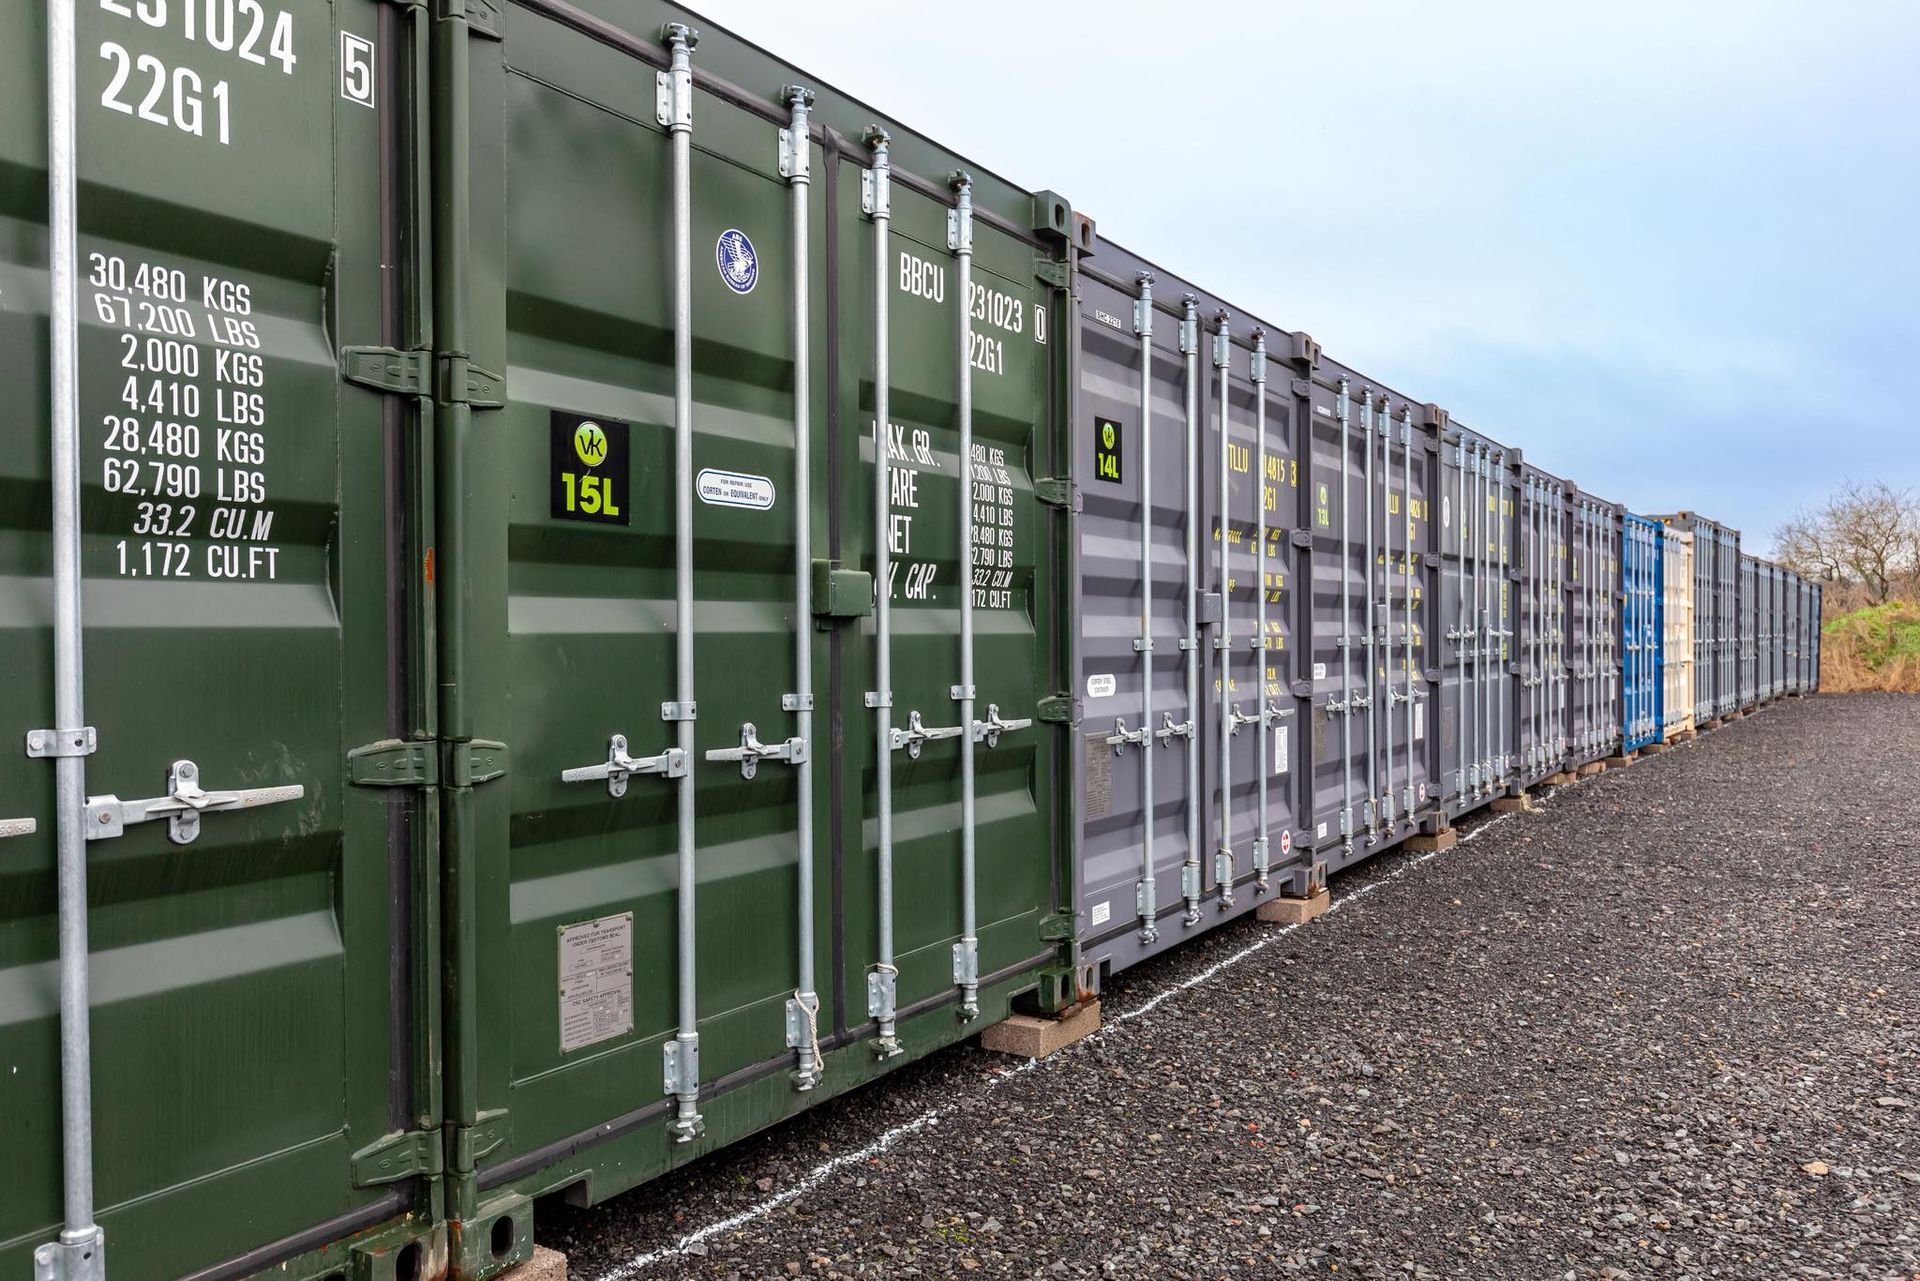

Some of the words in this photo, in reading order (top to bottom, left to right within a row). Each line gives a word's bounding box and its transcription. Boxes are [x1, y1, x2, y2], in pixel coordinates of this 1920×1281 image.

[100, 0, 297, 75] 1024
[345, 37, 370, 101] 5
[100, 41, 230, 145] 22G1
[203, 276, 251, 315] KGS
[900, 252, 944, 303] BBCU
[970, 281, 1023, 333] 231023
[207, 315, 260, 349] LBS
[120, 334, 199, 377] 2,000
[215, 349, 264, 387] KGS
[970, 330, 1003, 375] 22G1
[122, 375, 200, 418] 4,410
[216, 389, 265, 426] LBS
[103, 415, 200, 458] 28,480
[216, 428, 265, 464] KGS
[873, 420, 914, 462] AX.
[913, 429, 941, 467] GR.
[989, 447, 1004, 467] KGS
[1228, 443, 1248, 473] TLLU
[103, 458, 200, 498] 62,790
[217, 468, 265, 504] LBS
[992, 467, 1011, 485] LBS
[1098, 452, 1119, 478] 14L
[562, 472, 619, 516] 15L
[703, 486, 722, 496] CORTEN
[731, 489, 758, 500] EQUIVALENT
[888, 466, 918, 508] ARE
[998, 486, 1013, 506] KGS
[133, 502, 196, 537] 33.2
[209, 508, 274, 541] CU.M
[970, 525, 995, 545] 8,480
[998, 528, 1013, 547] KGS
[998, 507, 1013, 527] LBS
[116, 540, 191, 576] 1,172
[207, 545, 279, 579] CU.FT
[970, 547, 995, 566] 2,790
[998, 549, 1013, 568] LBS
[905, 563, 936, 599] CAP.
[991, 570, 1013, 588] CU.M
[989, 590, 1011, 609] CU.FT
